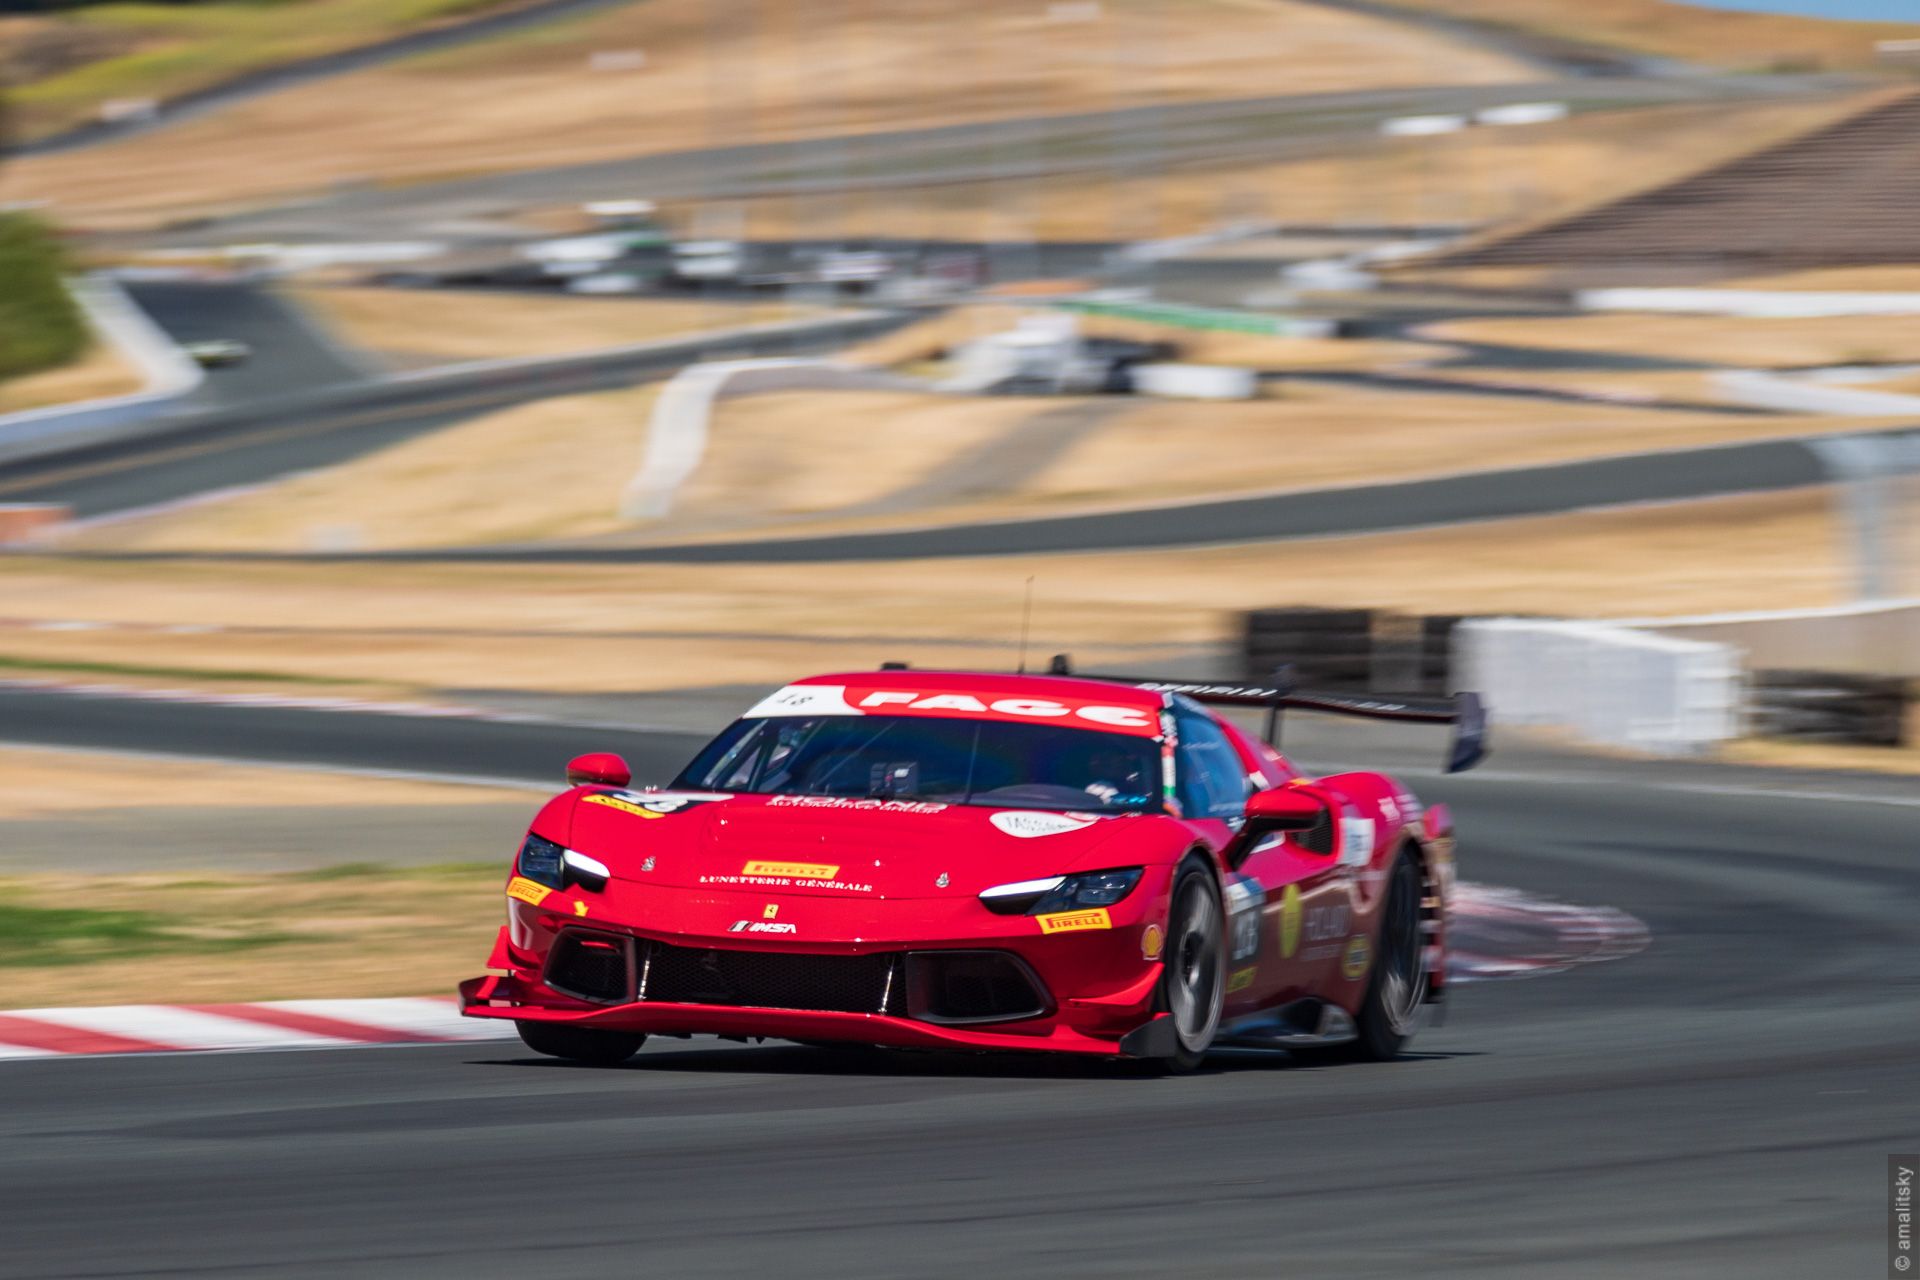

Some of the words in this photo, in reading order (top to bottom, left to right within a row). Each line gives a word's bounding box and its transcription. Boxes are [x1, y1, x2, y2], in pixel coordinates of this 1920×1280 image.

[699, 875, 791, 886] LUNETTERIE
[795, 878, 873, 892] GÉNÉRALE
[749, 921, 797, 934] IMSA
[1046, 911, 1104, 929] PIRELLI
